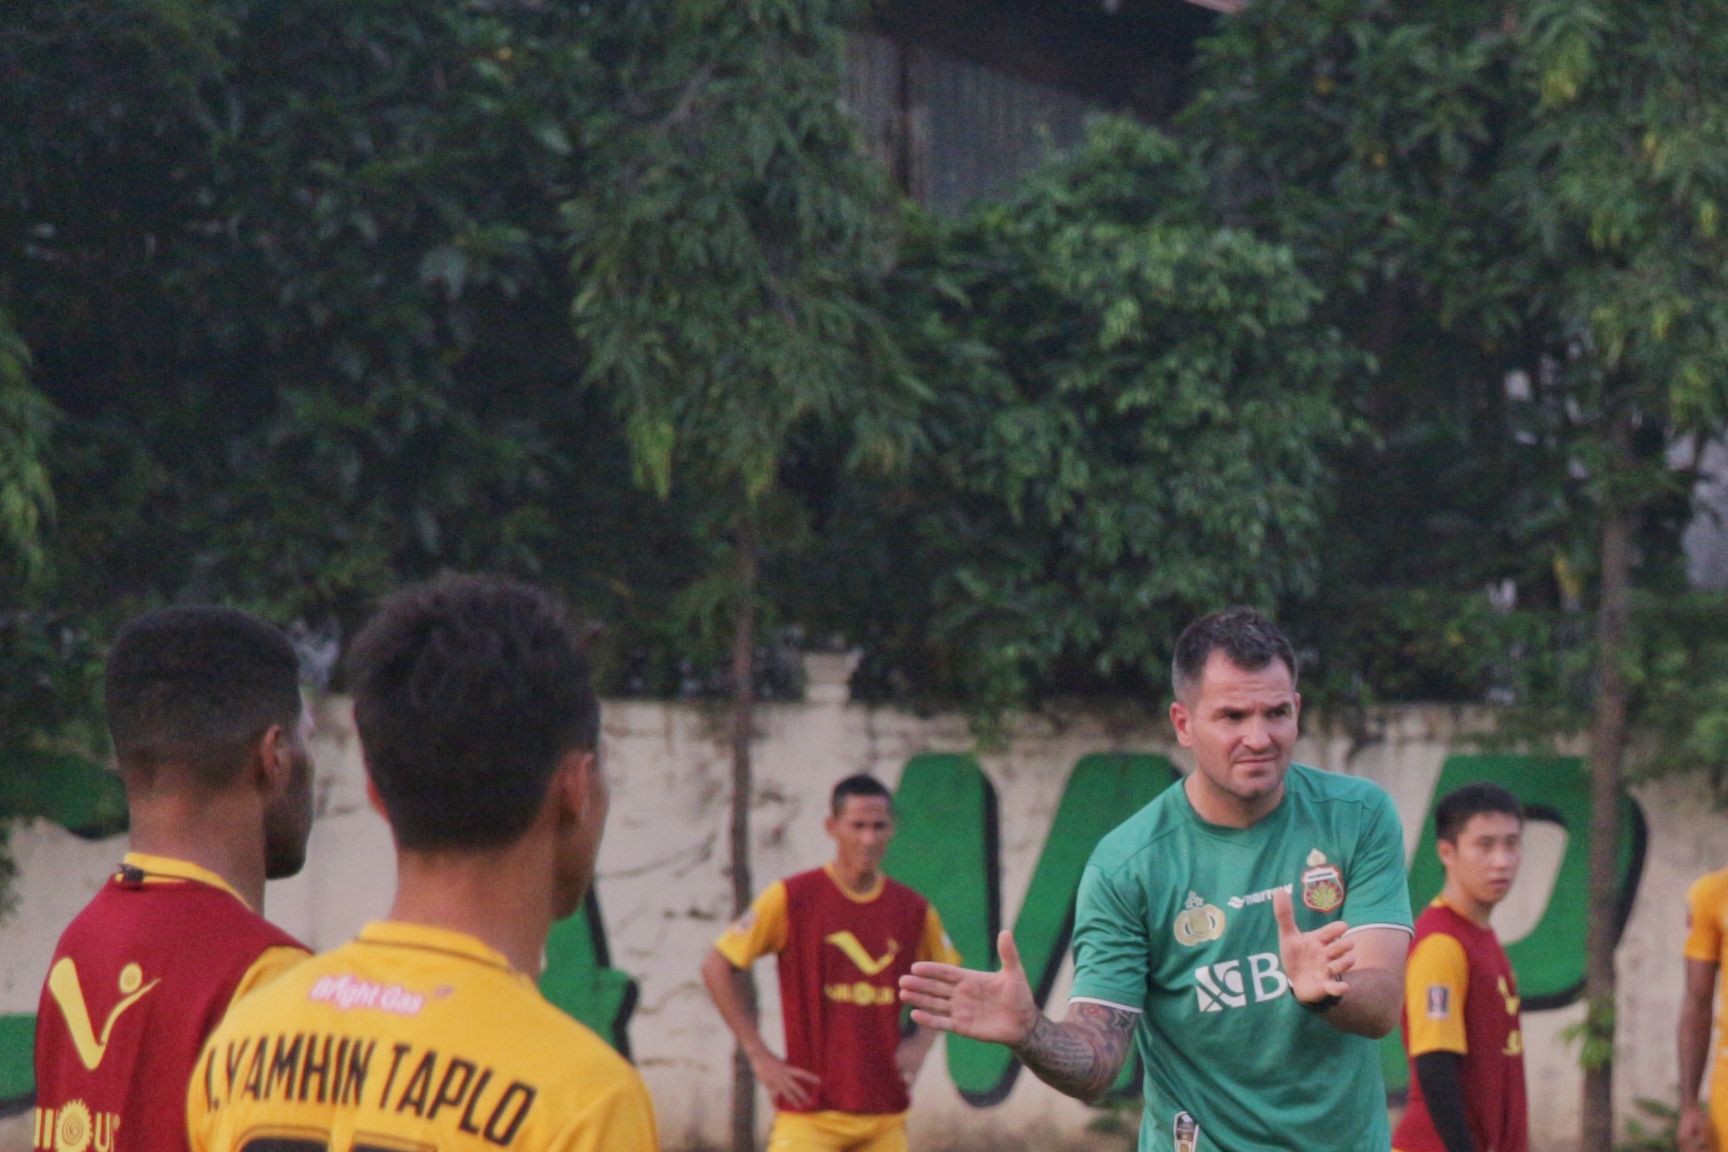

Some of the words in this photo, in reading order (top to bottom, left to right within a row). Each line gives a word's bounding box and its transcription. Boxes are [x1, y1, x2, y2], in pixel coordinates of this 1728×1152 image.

[310, 973, 382, 1010] Bright
[379, 984, 425, 1017] Gas
[1247, 952, 1294, 1003] B
[378, 1042, 538, 1149] TAPLO
